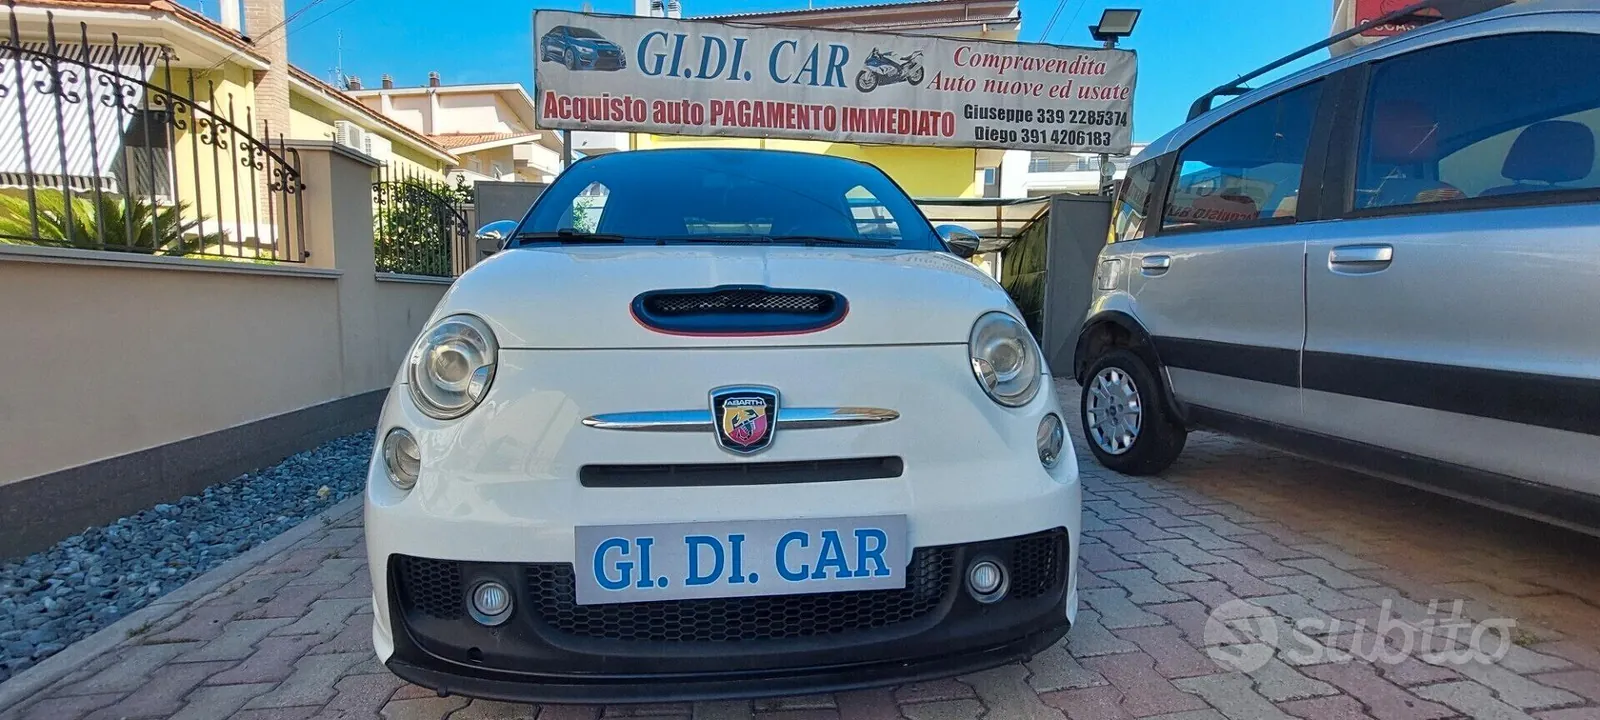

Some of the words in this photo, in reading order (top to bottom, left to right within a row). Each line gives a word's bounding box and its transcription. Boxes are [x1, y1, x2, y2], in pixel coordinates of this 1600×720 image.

[637, 31, 752, 81] GI.DI.
[768, 40, 850, 88] CAR
[953, 46, 1106, 76] Compravendita
[926, 70, 978, 93] Auto
[983, 79, 1043, 98] nuove
[1048, 79, 1072, 99] ed
[1078, 83, 1130, 101] usate
[543, 91, 647, 123] Acquisto
[652, 99, 704, 126] auto
[710, 100, 837, 132] PAGAMENTO
[842, 106, 956, 138] IMMEDIATO
[964, 104, 1033, 124] Giuseppe
[1037, 108, 1065, 125] 339
[1068, 109, 1128, 127] 2285374
[974, 126, 1017, 144] Diego
[1021, 126, 1049, 144] 391
[1050, 129, 1111, 147] 4206183
[593, 537, 669, 590] GI.
[684, 533, 759, 586] DI.
[774, 527, 891, 582] CAR
